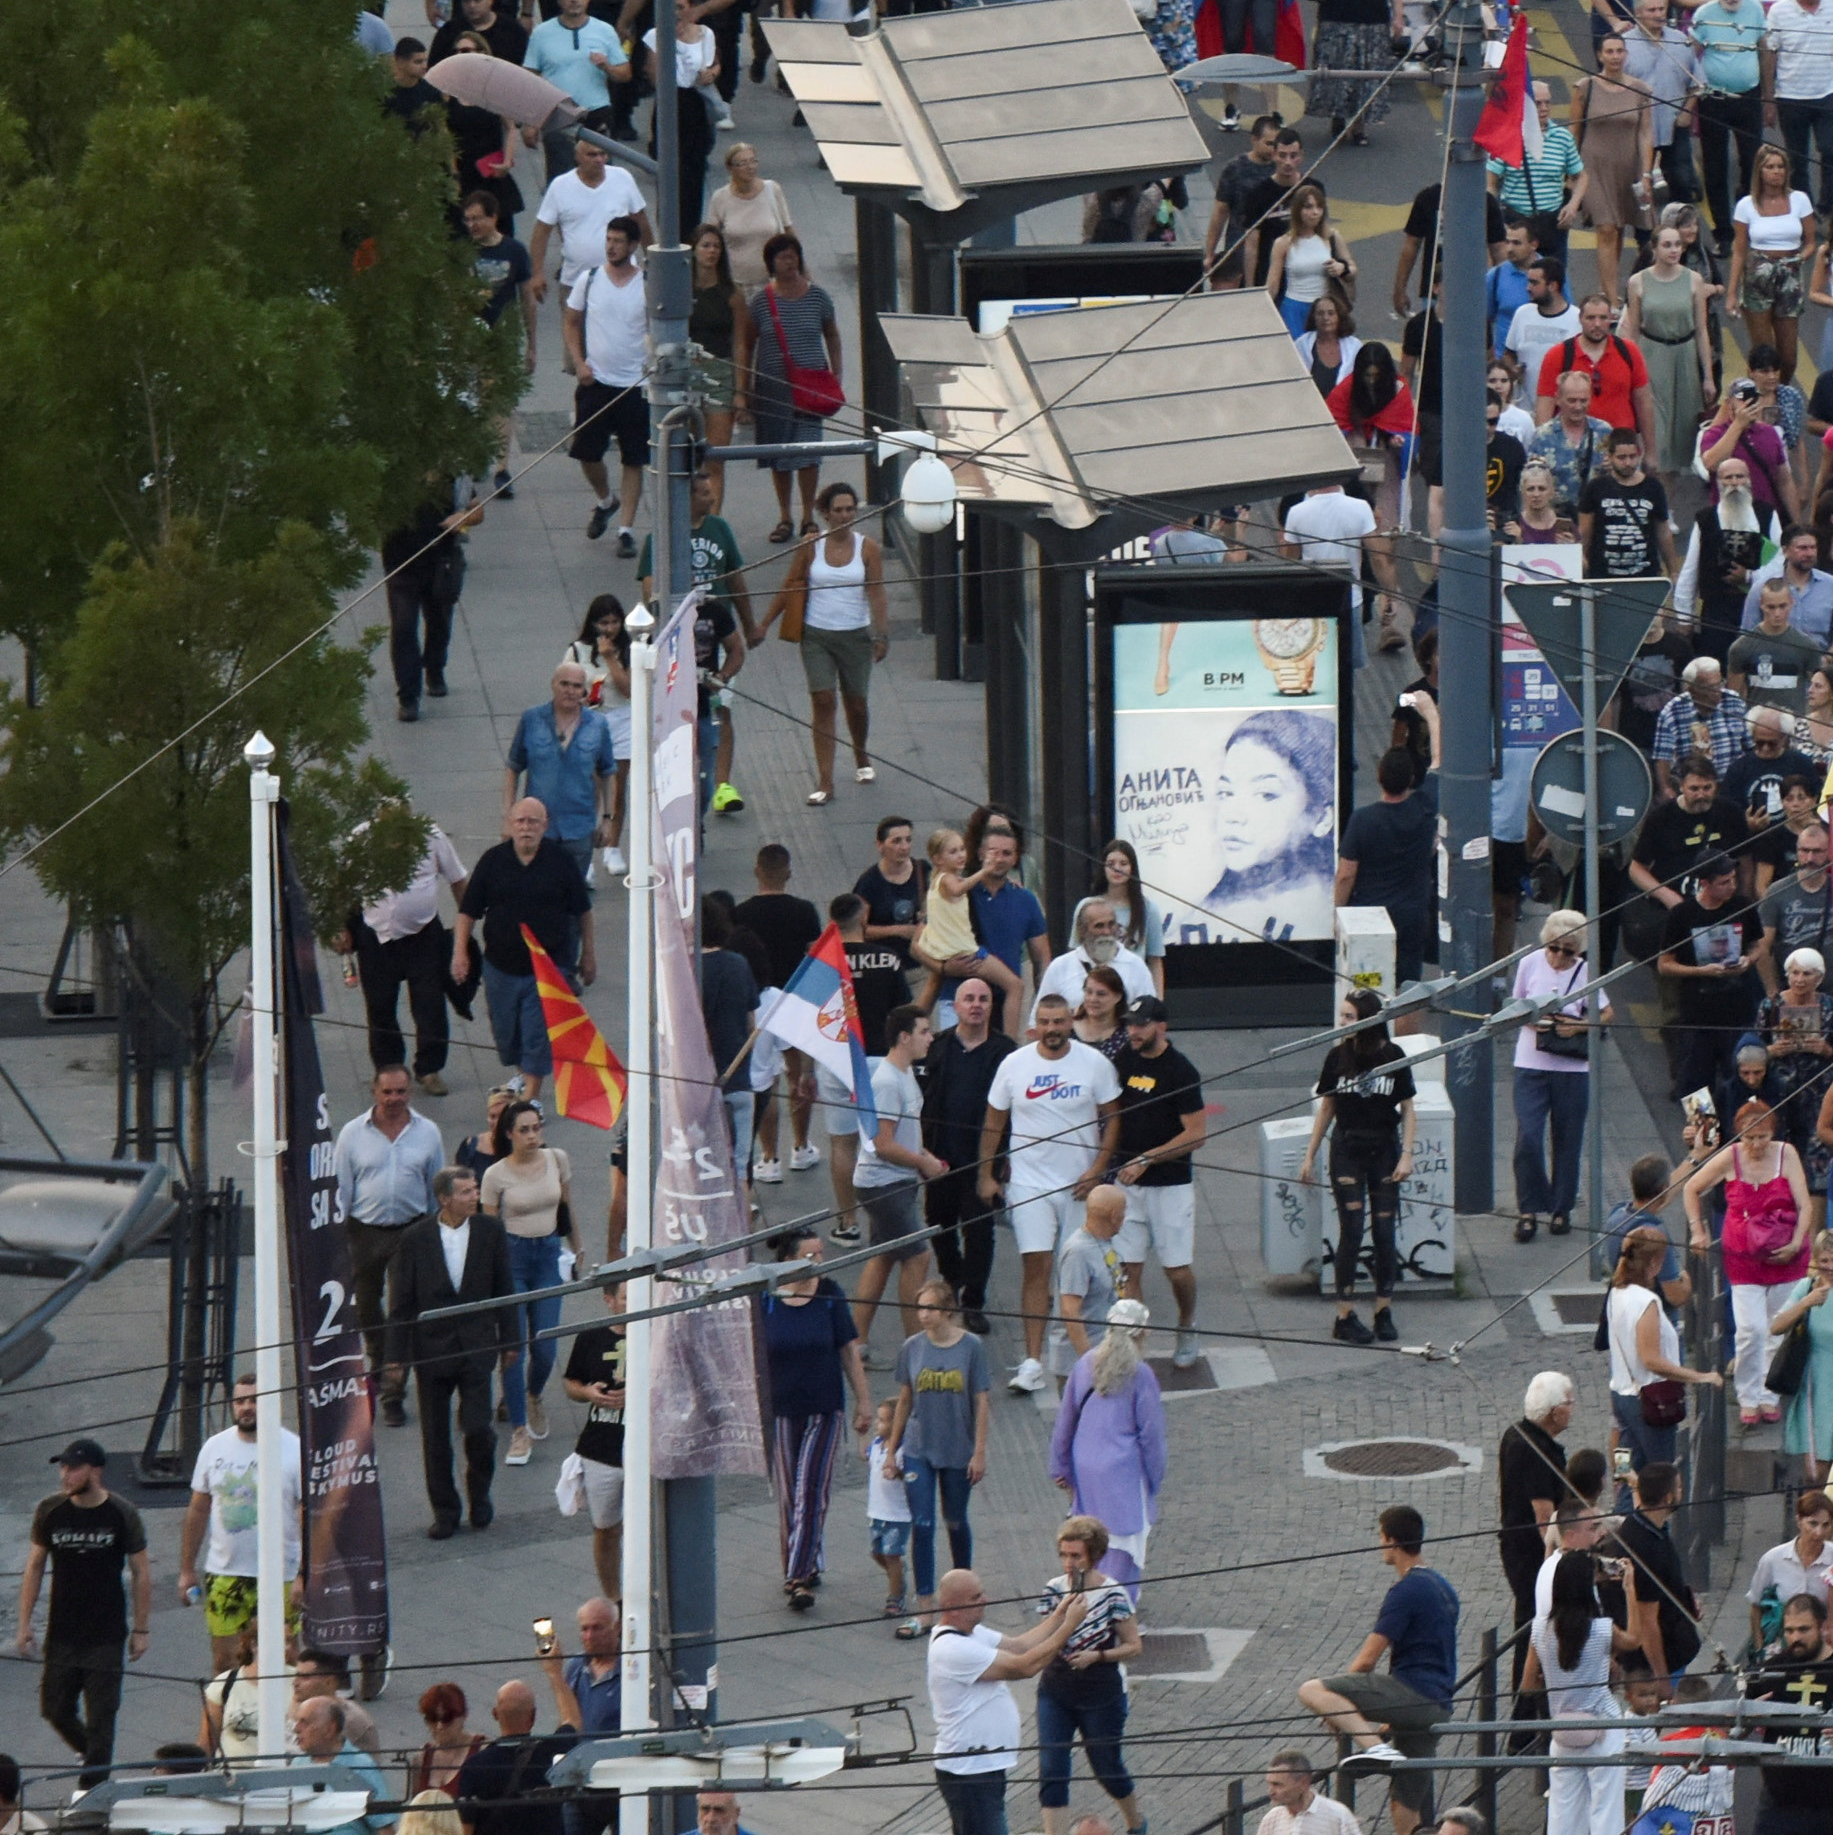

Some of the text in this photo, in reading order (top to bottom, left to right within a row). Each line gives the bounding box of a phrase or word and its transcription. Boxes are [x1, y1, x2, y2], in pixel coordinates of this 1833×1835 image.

[1119, 766, 1202, 795] АНИТА
[1118, 789, 1205, 813] ОГЊАНОВИЋ
[1032, 1074, 1060, 1087] JUST
